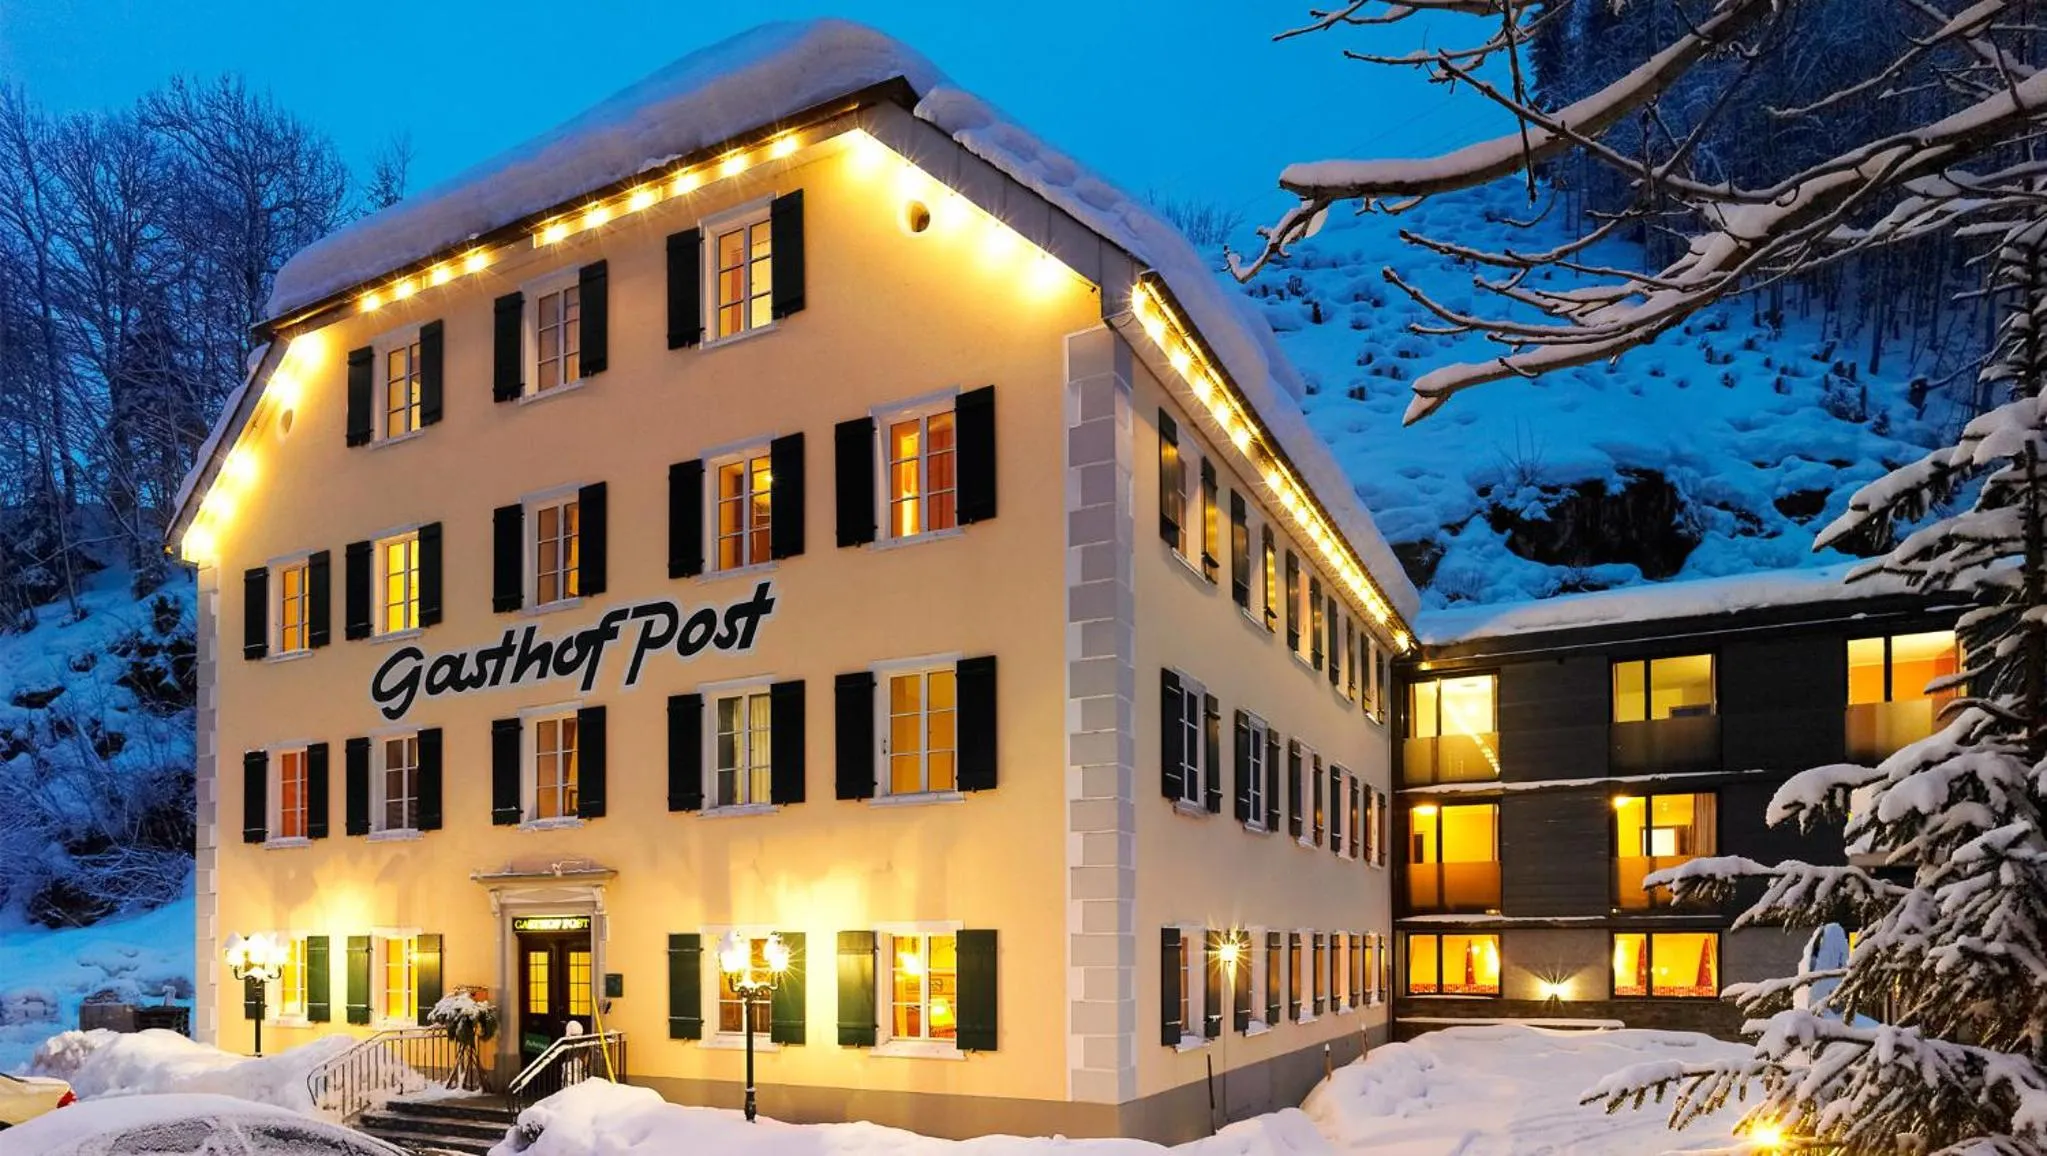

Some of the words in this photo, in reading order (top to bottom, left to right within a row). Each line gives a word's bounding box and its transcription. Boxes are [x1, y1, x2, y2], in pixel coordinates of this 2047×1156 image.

[371, 608, 630, 720] Gasthof
[624, 581, 776, 686] Post
[561, 917, 590, 930] POST
